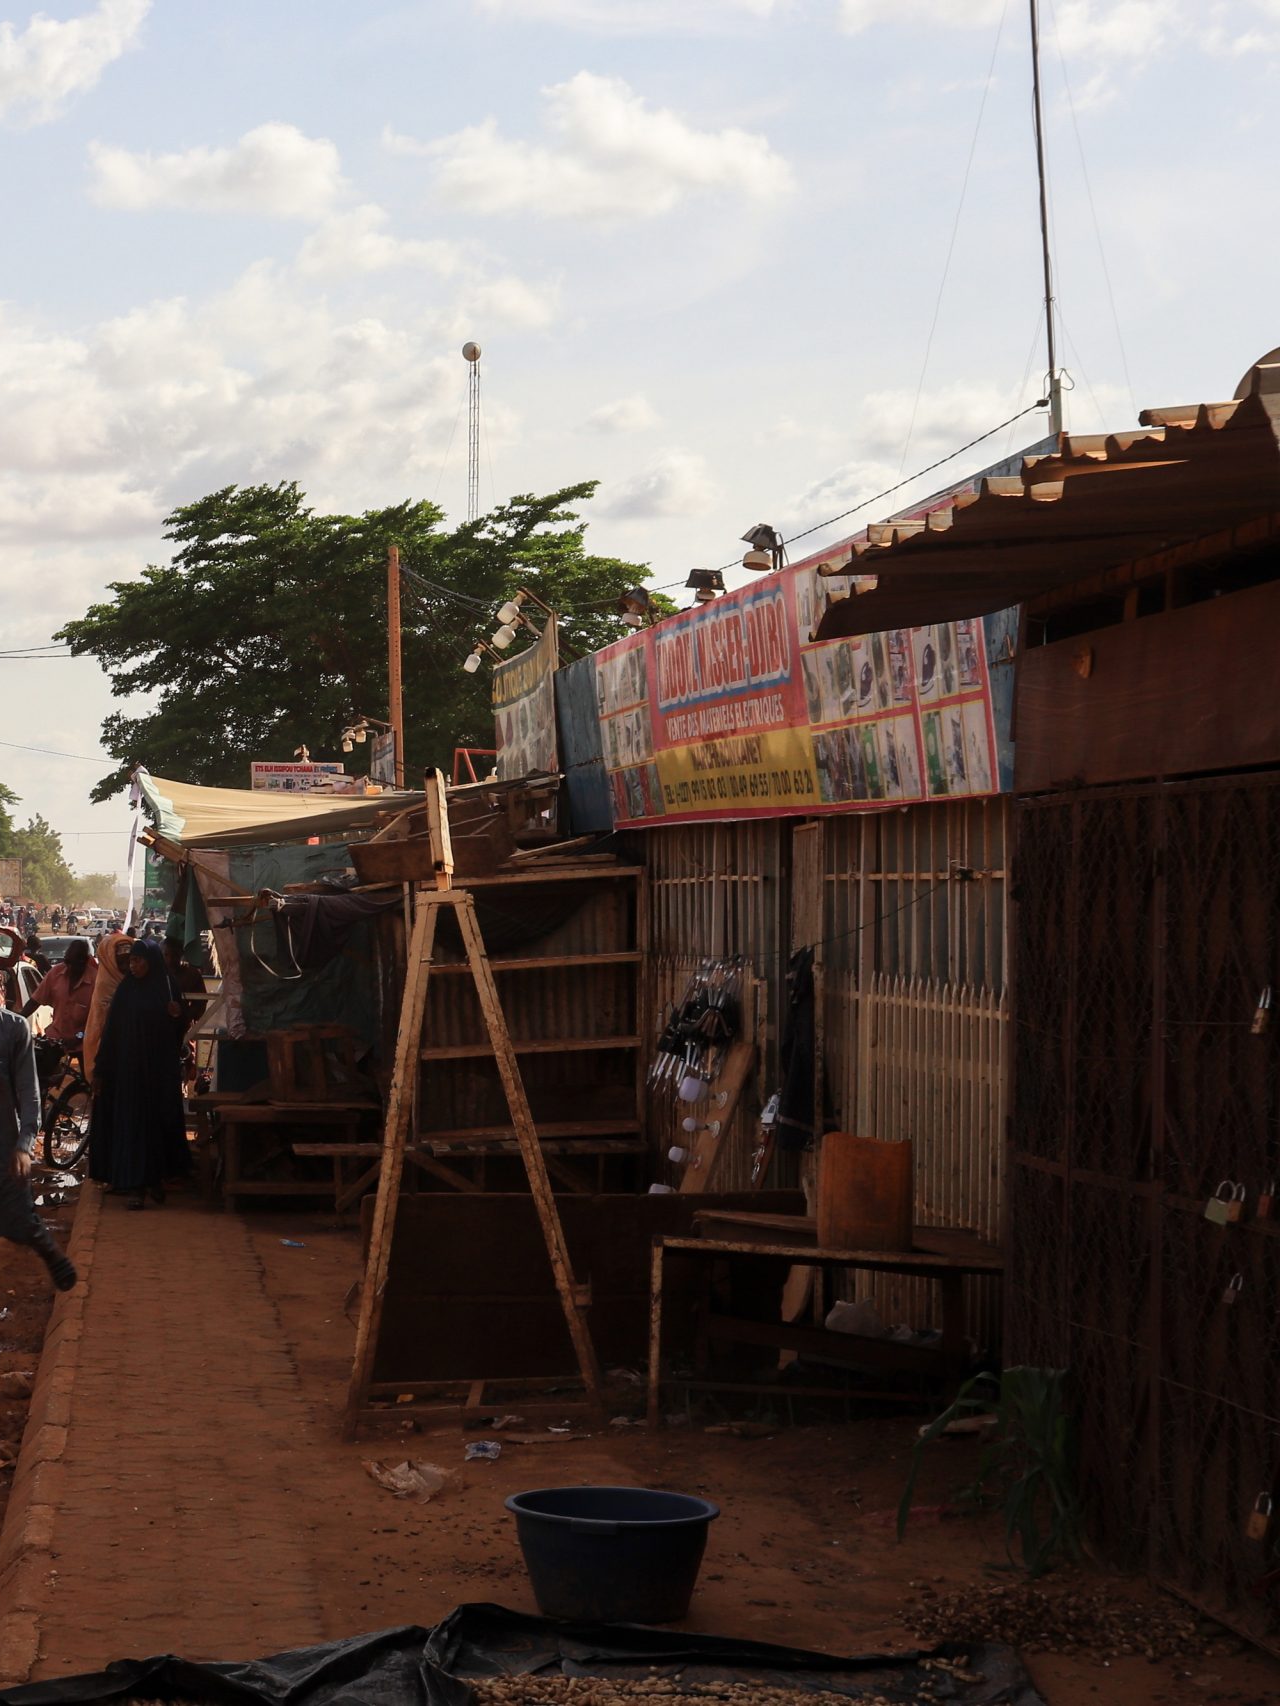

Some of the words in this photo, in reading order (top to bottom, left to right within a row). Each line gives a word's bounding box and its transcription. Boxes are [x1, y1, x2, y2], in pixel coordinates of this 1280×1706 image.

[656, 629, 699, 706] ABDOUL
[666, 714, 686, 741] VENTE
[687, 711, 699, 738] DES
[699, 703, 735, 734] MATERIELS
[734, 693, 784, 727] ELECTRIQUES
